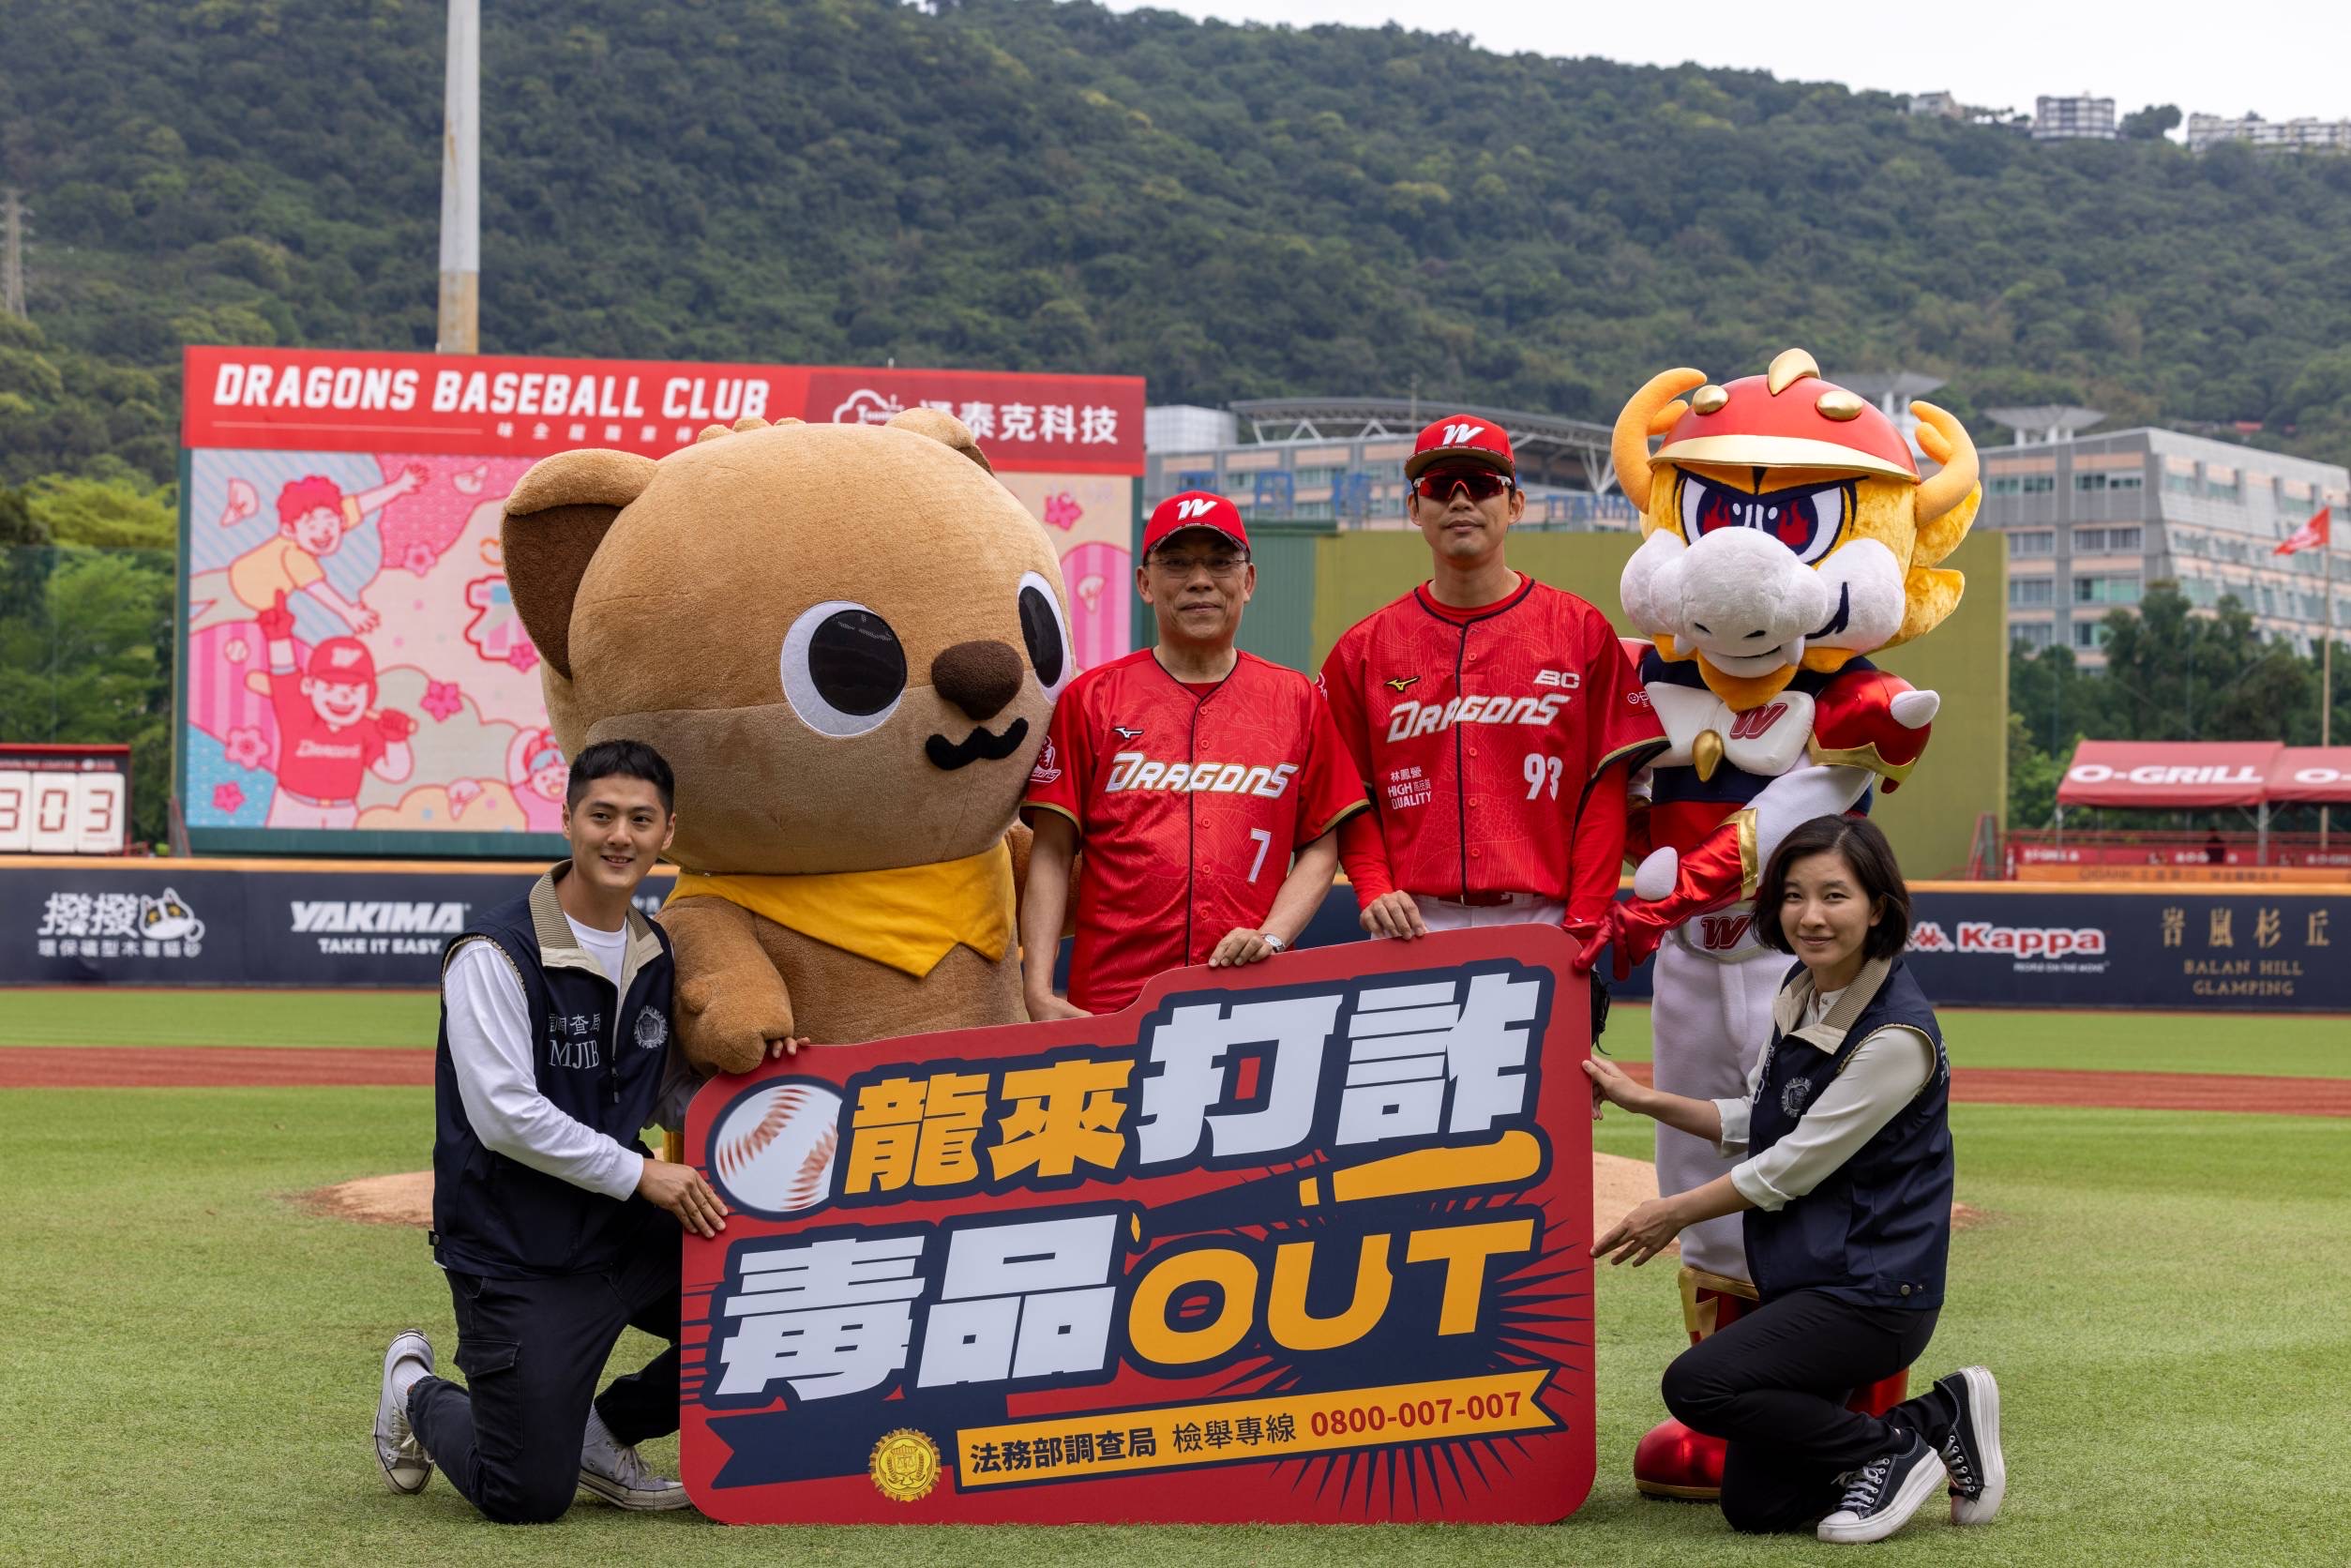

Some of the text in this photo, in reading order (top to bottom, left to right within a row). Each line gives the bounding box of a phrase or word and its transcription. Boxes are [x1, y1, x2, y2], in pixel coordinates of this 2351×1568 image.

[213, 364, 771, 420] DRAGONS BASEBALL CLUB
[920, 400, 1118, 445] 泰克科技
[1386, 694, 1572, 744] DRAGONS
[1106, 752, 1298, 798] DRAGONS
[1388, 782, 1413, 797] HIGH
[2069, 764, 2264, 785] O-GRILL
[1392, 791, 1432, 810] QUALITY
[1248, 829, 1271, 883] 7
[290, 901, 465, 933] YAKIMA
[318, 939, 367, 954] TAKE
[370, 939, 389, 954] IT
[1957, 923, 2105, 958] Kappa
[2183, 959, 2304, 976] BALAN HILL
[2193, 980, 2295, 996] GLAMPING
[548, 1013, 601, 1036] 調查局
[549, 1039, 600, 1069] MJIB
[842, 972, 1541, 1196] 龍來打詐
[716, 1214, 1534, 1401] 毒品 OUT
[970, 1390, 1523, 1475] 法務部調查局 檢舉專線 0800-007-007
